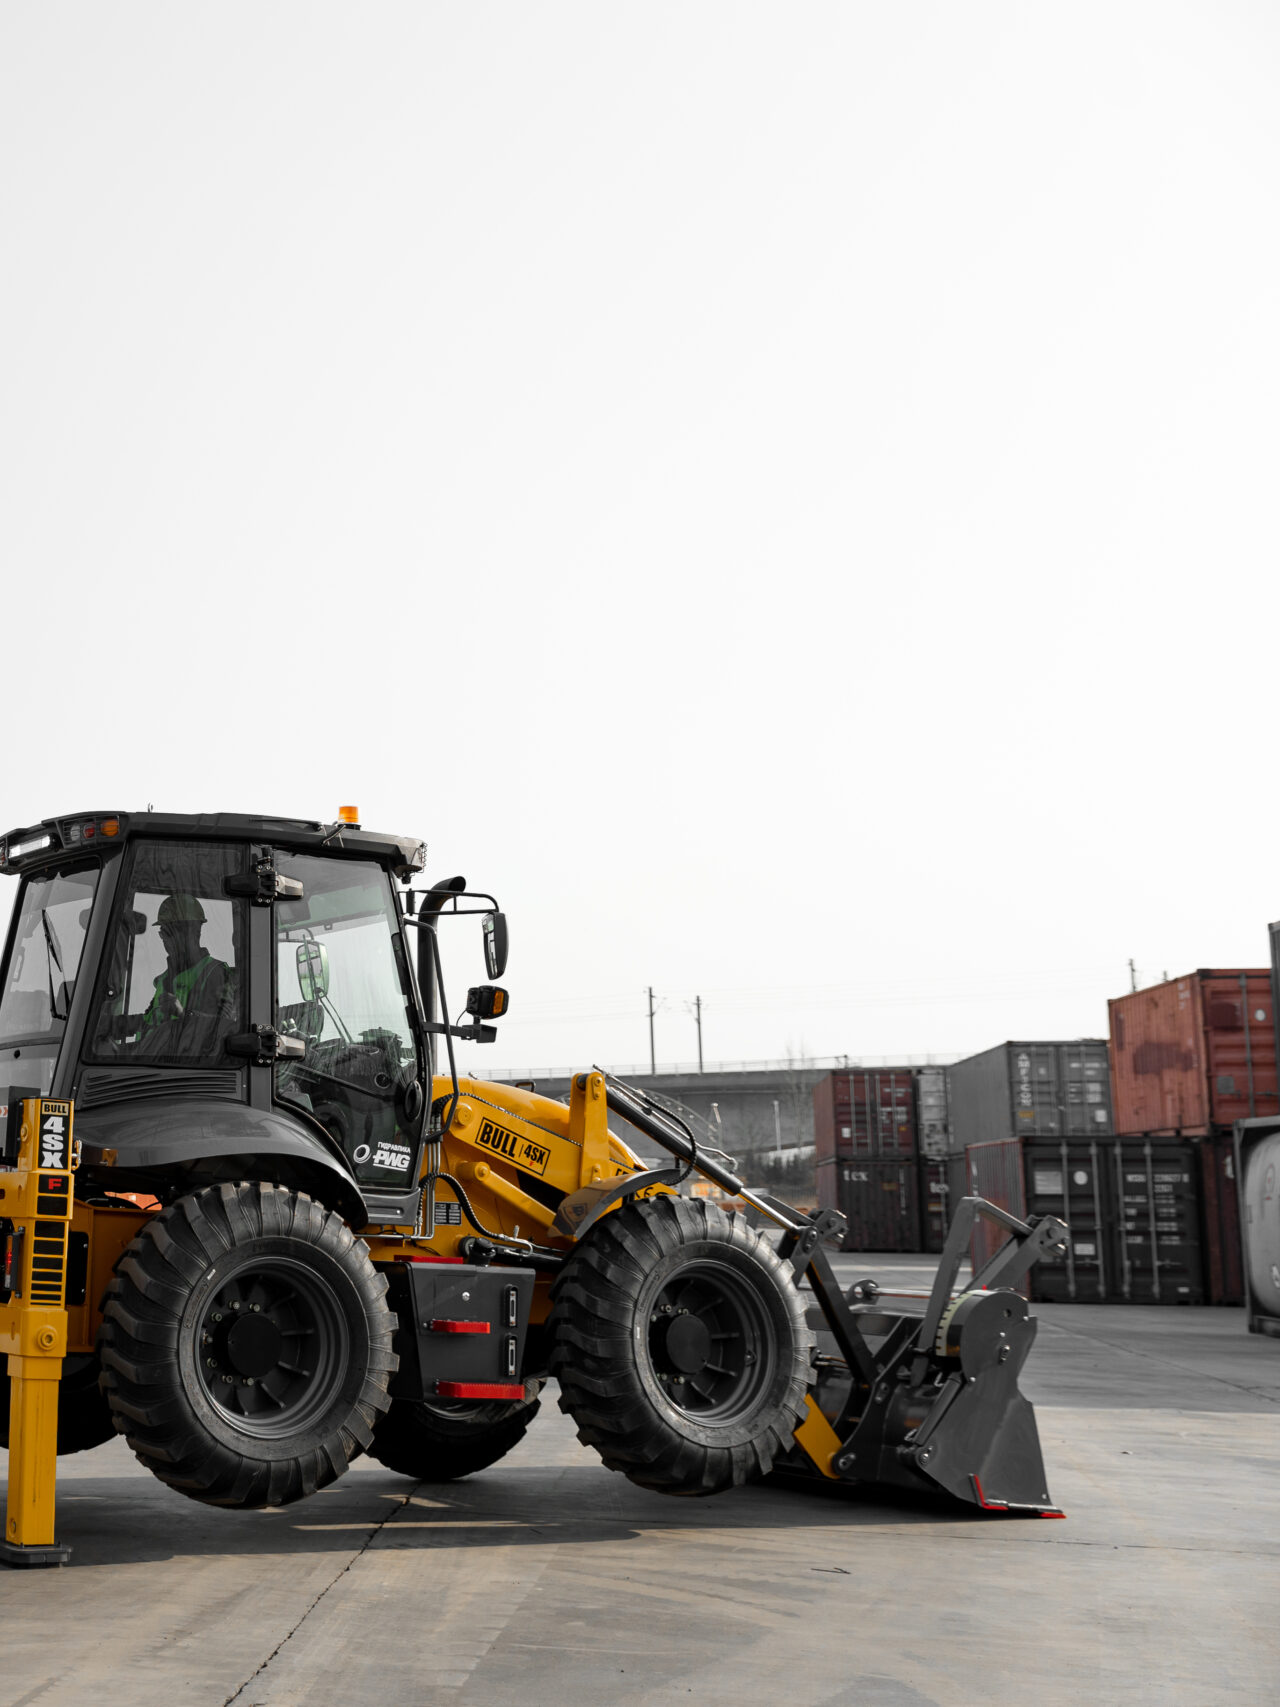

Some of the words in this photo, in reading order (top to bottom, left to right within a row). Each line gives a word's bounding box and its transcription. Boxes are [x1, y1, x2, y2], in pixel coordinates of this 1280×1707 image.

[44, 1103, 67, 1114] BULL
[41, 1115, 65, 1168] 4SX
[479, 1122, 518, 1158] BULL
[523, 1144, 546, 1165] 4SX
[372, 1149, 411, 1169] PWG
[843, 1169, 869, 1181] tex
[48, 1178, 63, 1190] F
